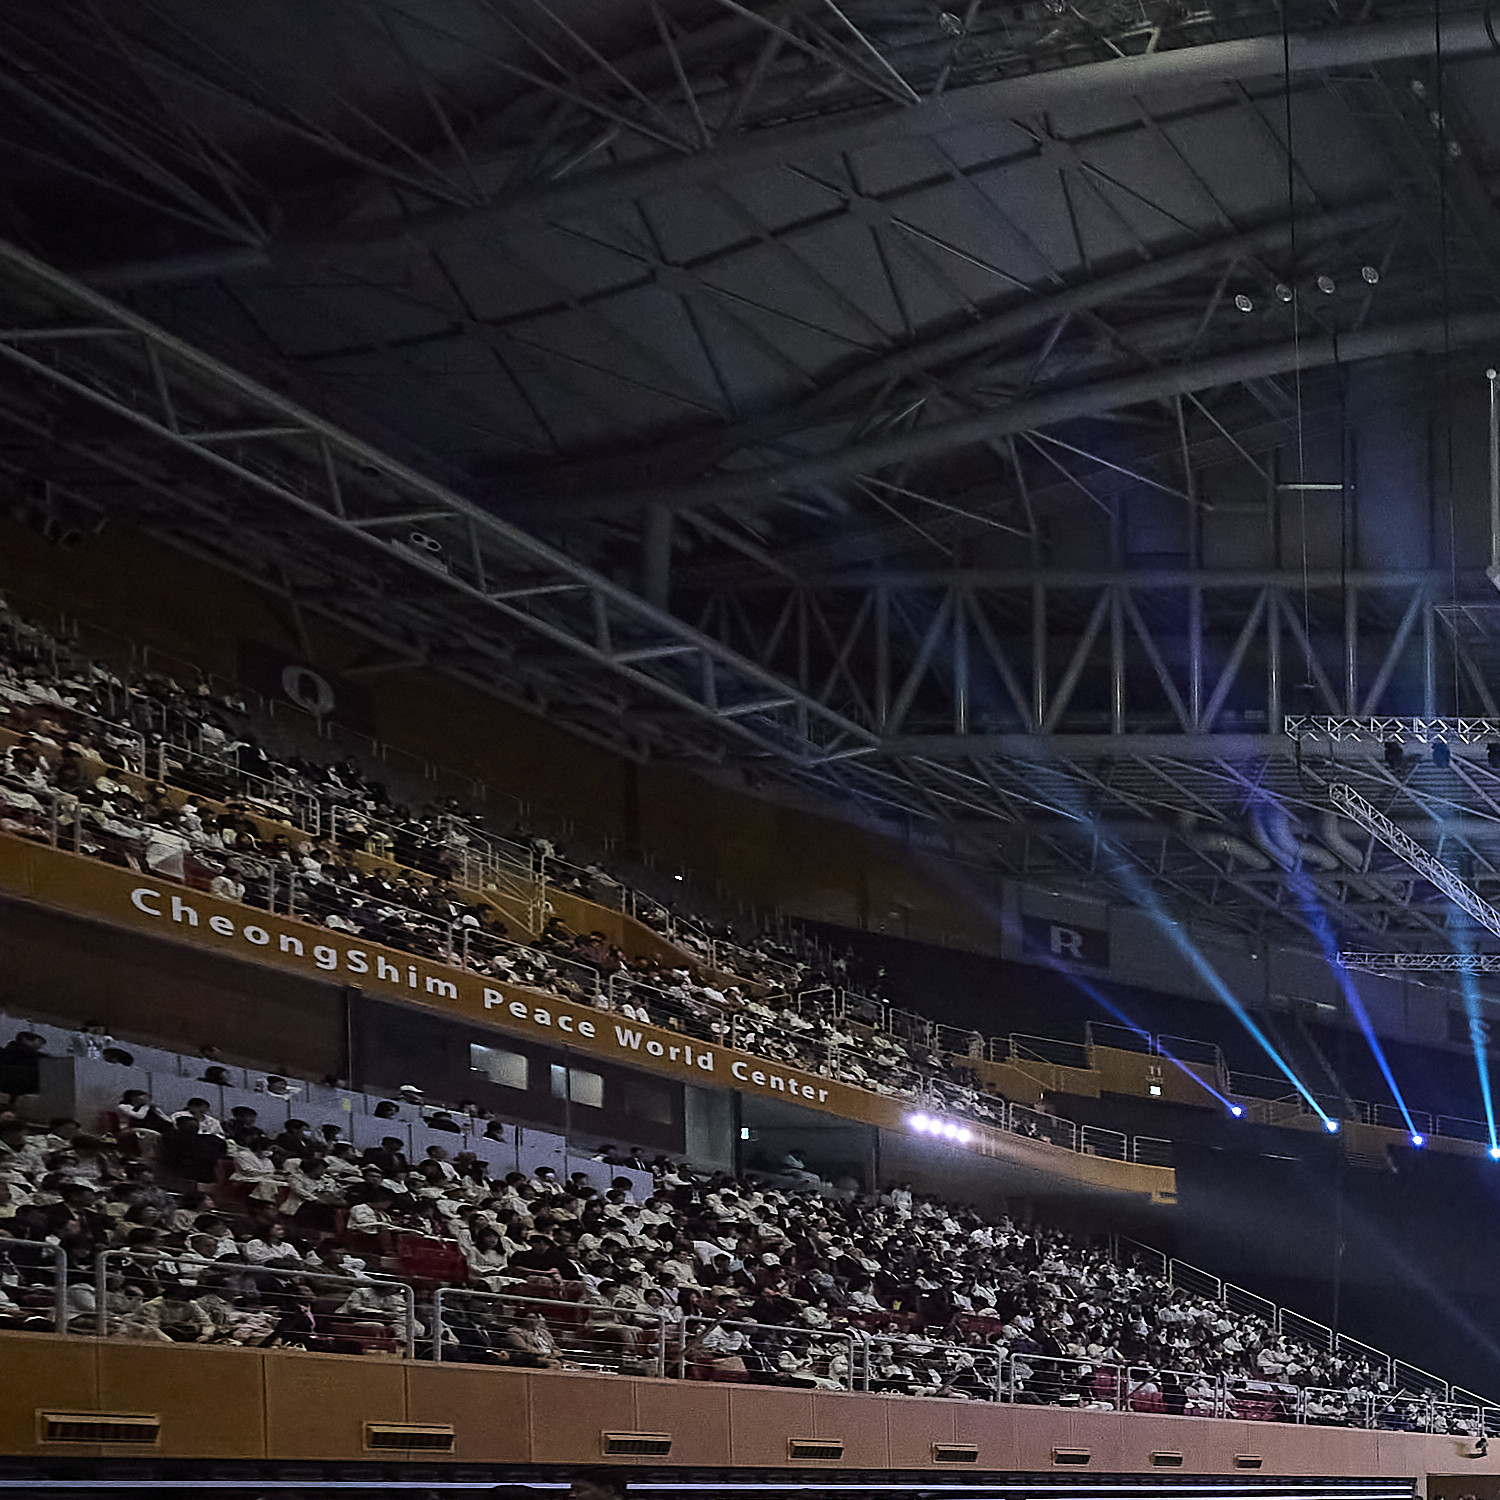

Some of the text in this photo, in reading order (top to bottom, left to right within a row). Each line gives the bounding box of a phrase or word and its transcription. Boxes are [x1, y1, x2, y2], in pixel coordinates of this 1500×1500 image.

[281, 665, 336, 717] Q
[1050, 925, 1083, 959] R
[130, 887, 830, 1103] CheongShim Peace World Center
[1147, 1065, 1162, 1077] 11
